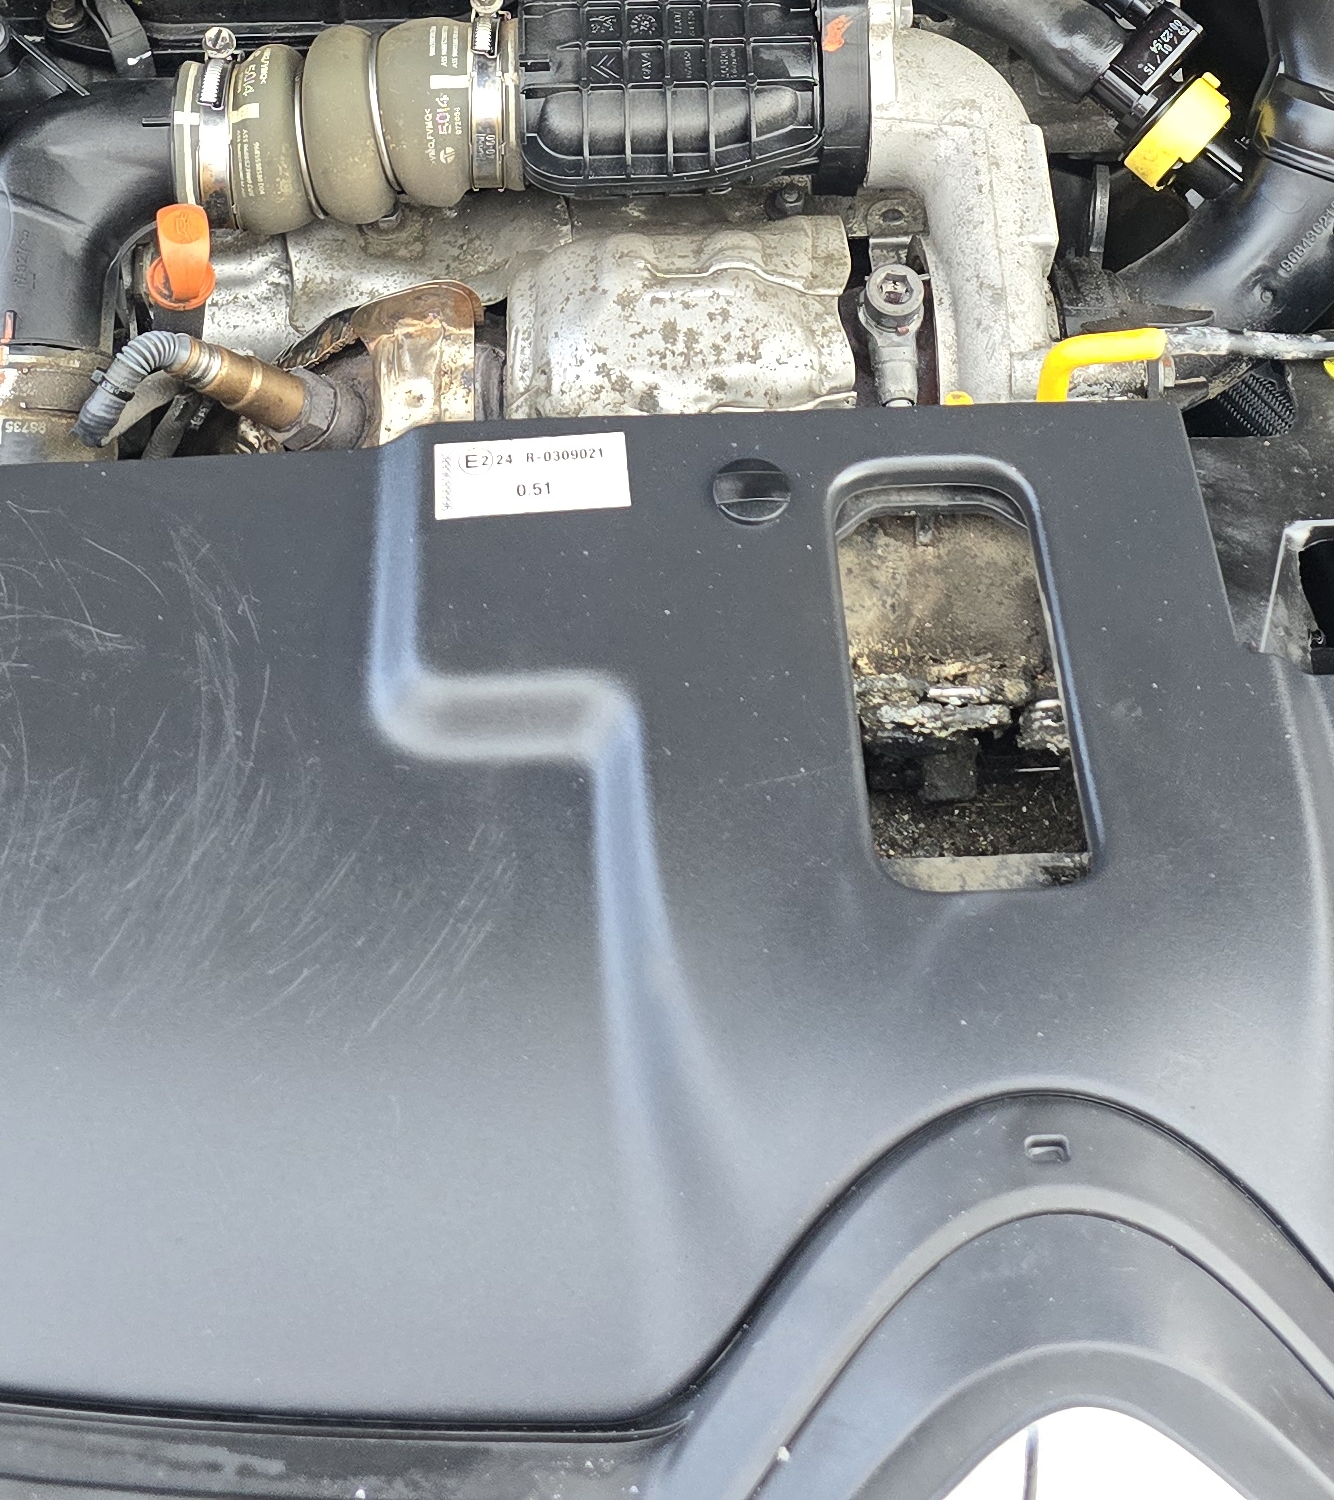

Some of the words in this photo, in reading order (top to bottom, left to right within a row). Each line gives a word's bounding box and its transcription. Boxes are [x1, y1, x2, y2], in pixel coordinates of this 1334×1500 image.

[496, 453, 513, 465] 24
[526, 447, 604, 463] R-0309021
[516, 482, 552, 497] 0.51
